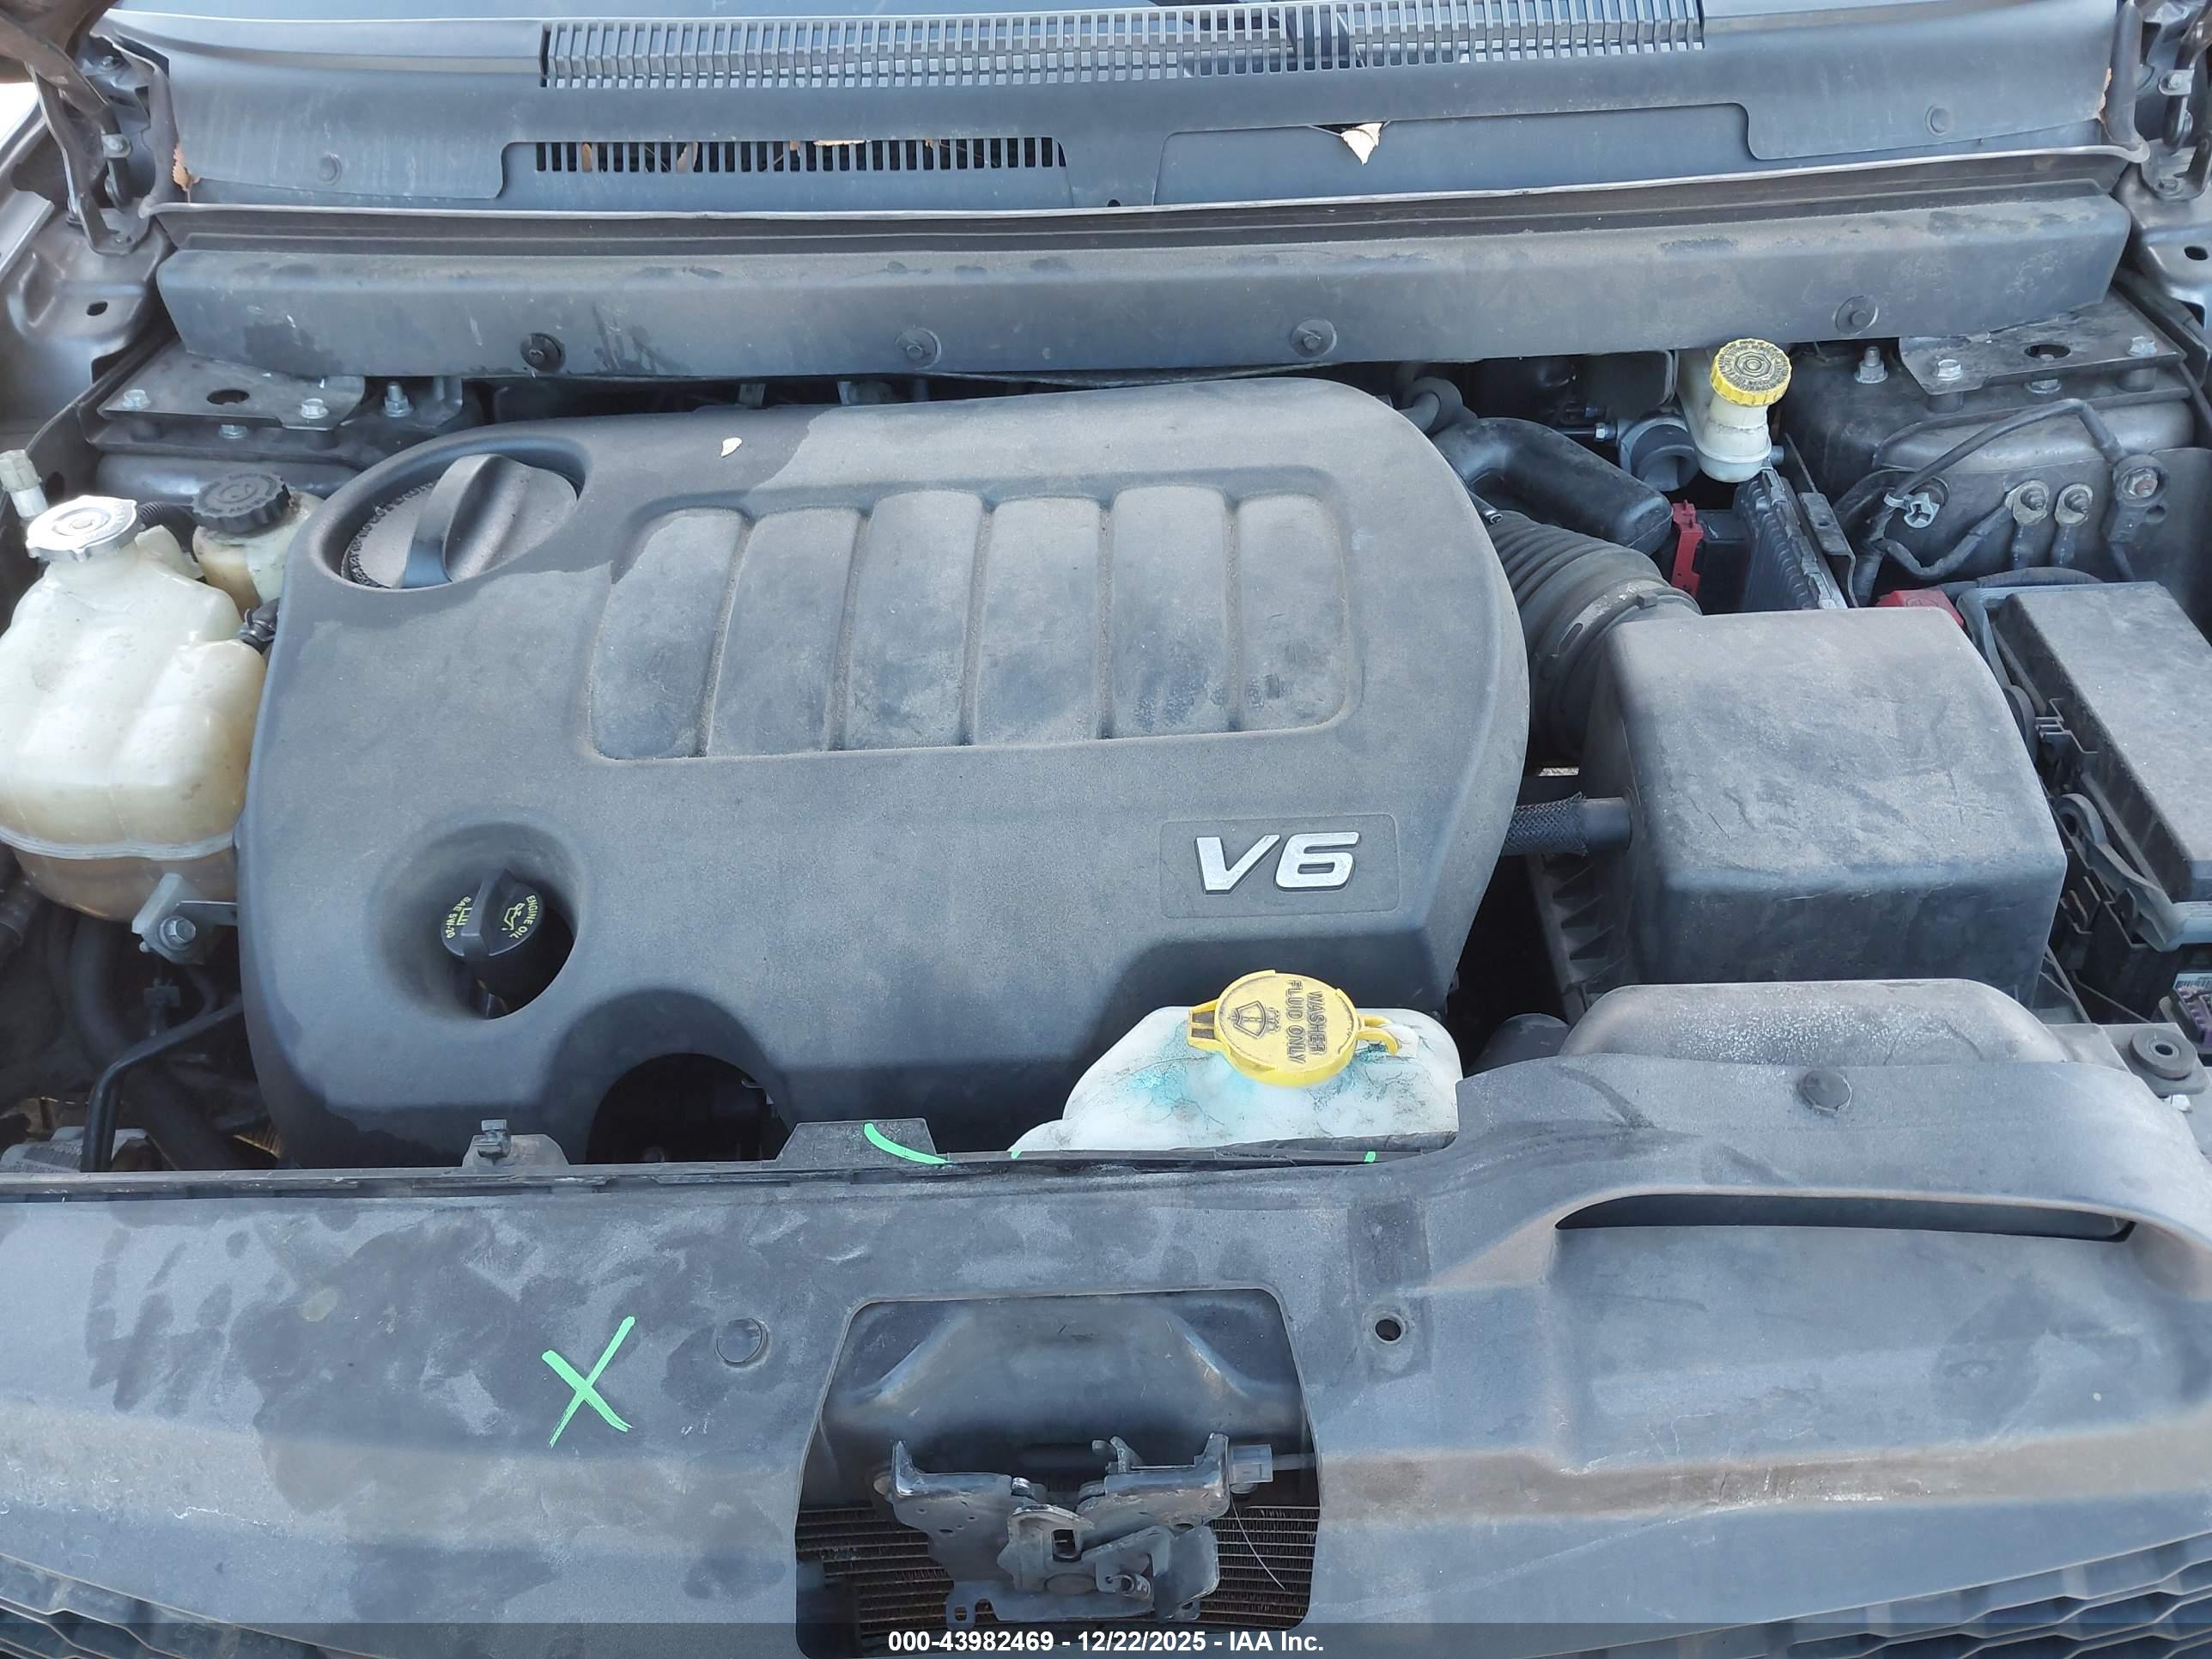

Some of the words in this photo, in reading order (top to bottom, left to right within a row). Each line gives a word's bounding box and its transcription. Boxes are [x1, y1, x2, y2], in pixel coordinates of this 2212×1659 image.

[1194, 831, 1360, 895] V6
[445, 913, 456, 939] 5W-20
[525, 894, 539, 926] ENGINE
[508, 925, 528, 939] OIL
[1286, 979, 1304, 1021] FLUID
[1306, 990, 1328, 1056] WASHER
[1287, 1024, 1307, 1065] ONLY
